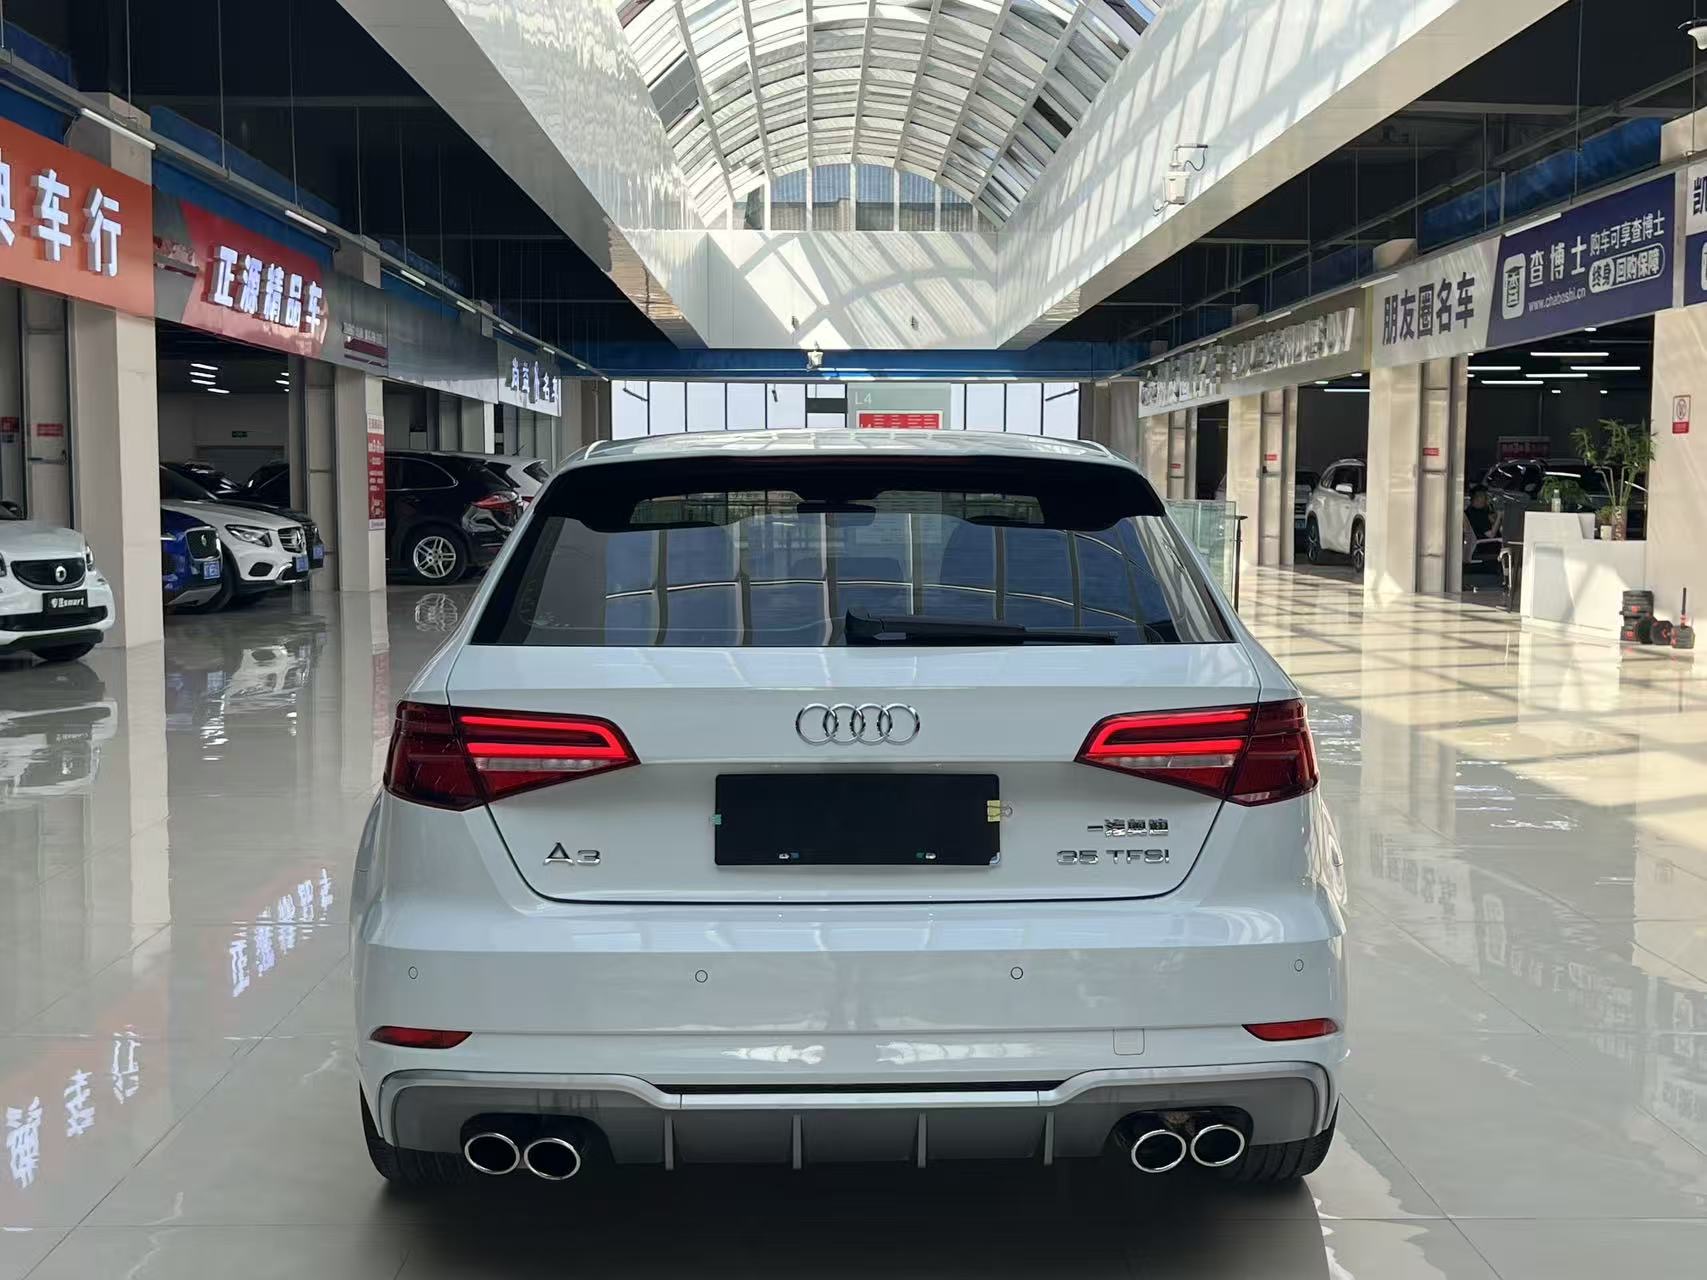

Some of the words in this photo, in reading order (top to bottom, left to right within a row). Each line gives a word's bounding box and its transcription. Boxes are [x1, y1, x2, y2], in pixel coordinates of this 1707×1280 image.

[1590, 210, 1665, 257] 购车可享查博士
[1529, 236, 1588, 288] 查博士
[1383, 272, 1475, 345] 朋友圈名车
[855, 391, 872, 405] L4
[543, 841, 601, 866] A3
[1057, 850, 1099, 865] 35
[1106, 849, 1170, 865] TFSI
